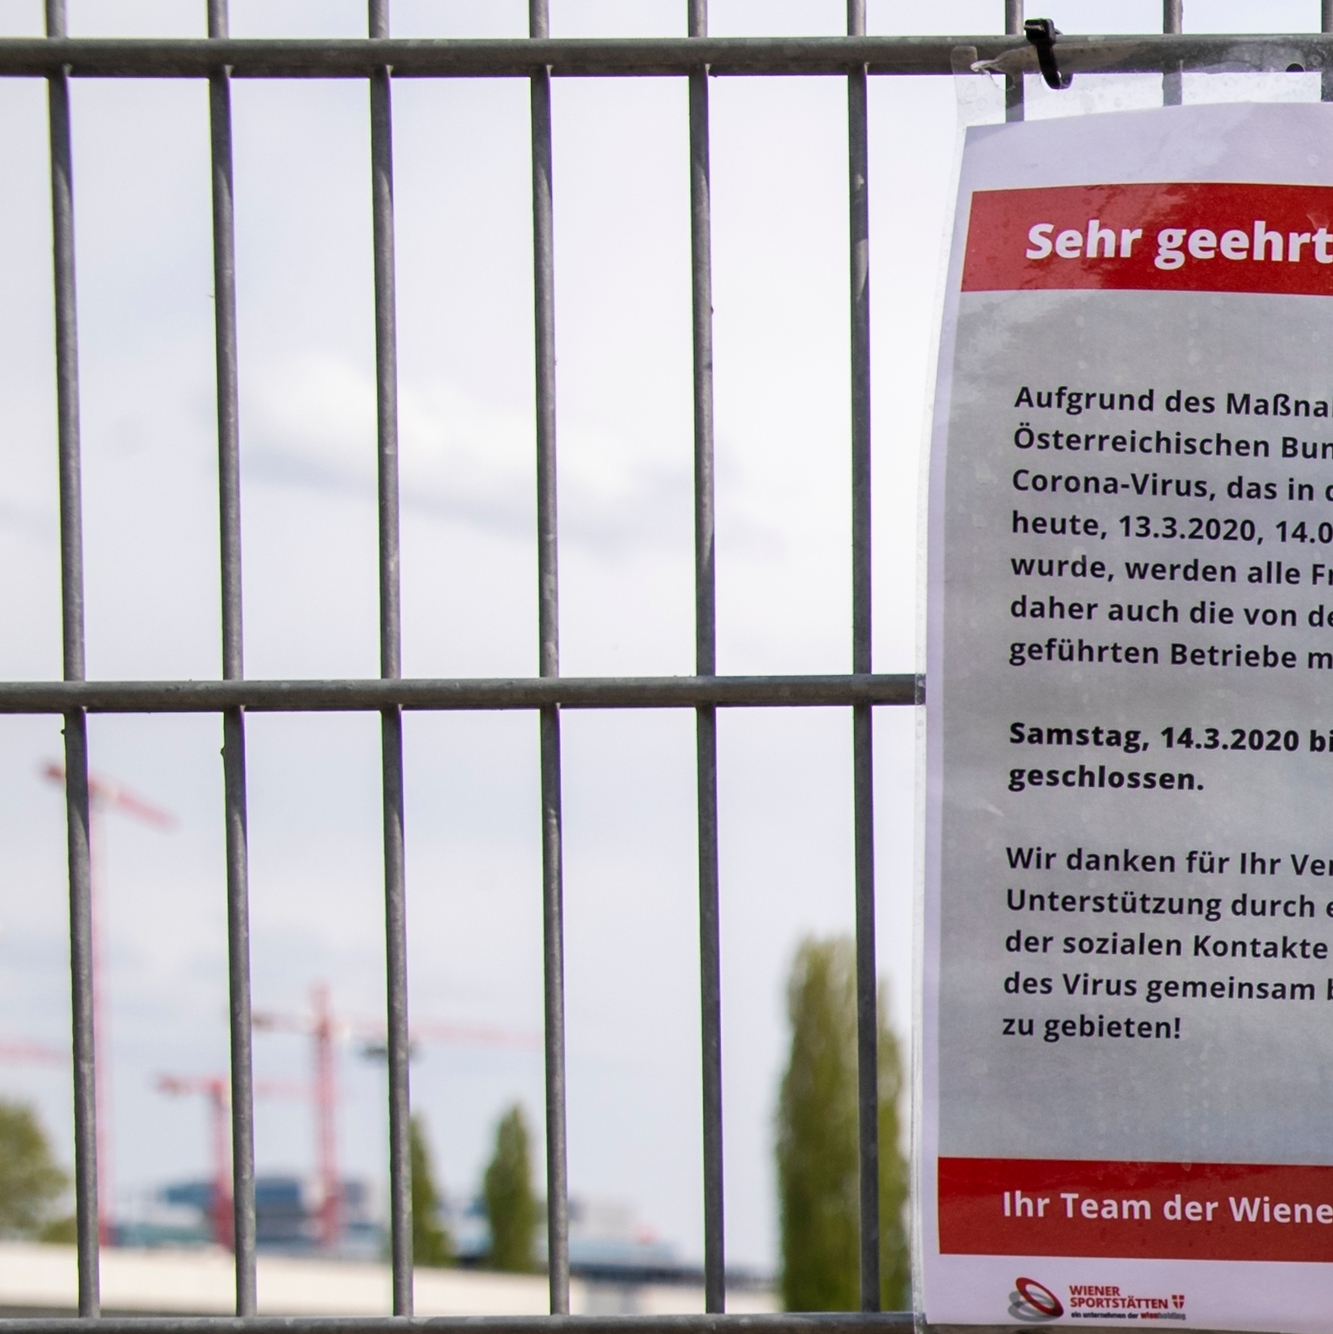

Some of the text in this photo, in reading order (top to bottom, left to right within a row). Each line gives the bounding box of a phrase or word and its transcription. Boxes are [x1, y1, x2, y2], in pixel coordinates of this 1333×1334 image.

[1025, 220, 1144, 261] Sehr
[1012, 384, 1156, 417] Aufgrund
[1163, 388, 1217, 415] des
[1012, 420, 1271, 459] Österreichischen
[1011, 467, 1217, 503] Corona-Virus,
[1225, 474, 1279, 501] das
[1287, 476, 1316, 503] in
[1011, 508, 1109, 541] heute,
[1117, 513, 1265, 547] 13.3.2020,
[1009, 553, 1116, 584] wurde,
[1123, 557, 1238, 584] werden
[1246, 559, 1302, 586] alle
[1009, 593, 1100, 622] daher
[1106, 598, 1180, 624] auch
[1188, 599, 1236, 626] die
[1242, 606, 1298, 628] von
[1007, 636, 1160, 668] geführten
[1169, 641, 1298, 670] Betriebe
[1008, 720, 1151, 755] Samstag,
[1159, 725, 1301, 753] 14.3.2020
[1006, 763, 1206, 794] geschlossen.
[1004, 845, 1058, 871] Wir
[1065, 846, 1177, 874] danken
[1184, 848, 1232, 875] für
[1239, 850, 1283, 877] Ihr
[1005, 887, 1224, 923] Unterstützung
[1229, 891, 1317, 919] durch
[1004, 928, 1055, 955] der
[1061, 930, 1183, 958] sozialen
[1192, 933, 1330, 961] Kontakte
[1002, 969, 1054, 996] des
[1061, 971, 1139, 998] Virus
[1144, 974, 1317, 1005] gemeinsam
[1000, 1012, 1182, 1044] zu gebieten!
[1002, 1188, 1052, 1219] Ihr
[1058, 1191, 1153, 1221] Team
[1162, 1192, 1220, 1223] der
[1069, 1285, 1120, 1297] WIENER
[1070, 1295, 1169, 1309] SPORTSTÄTTEN
